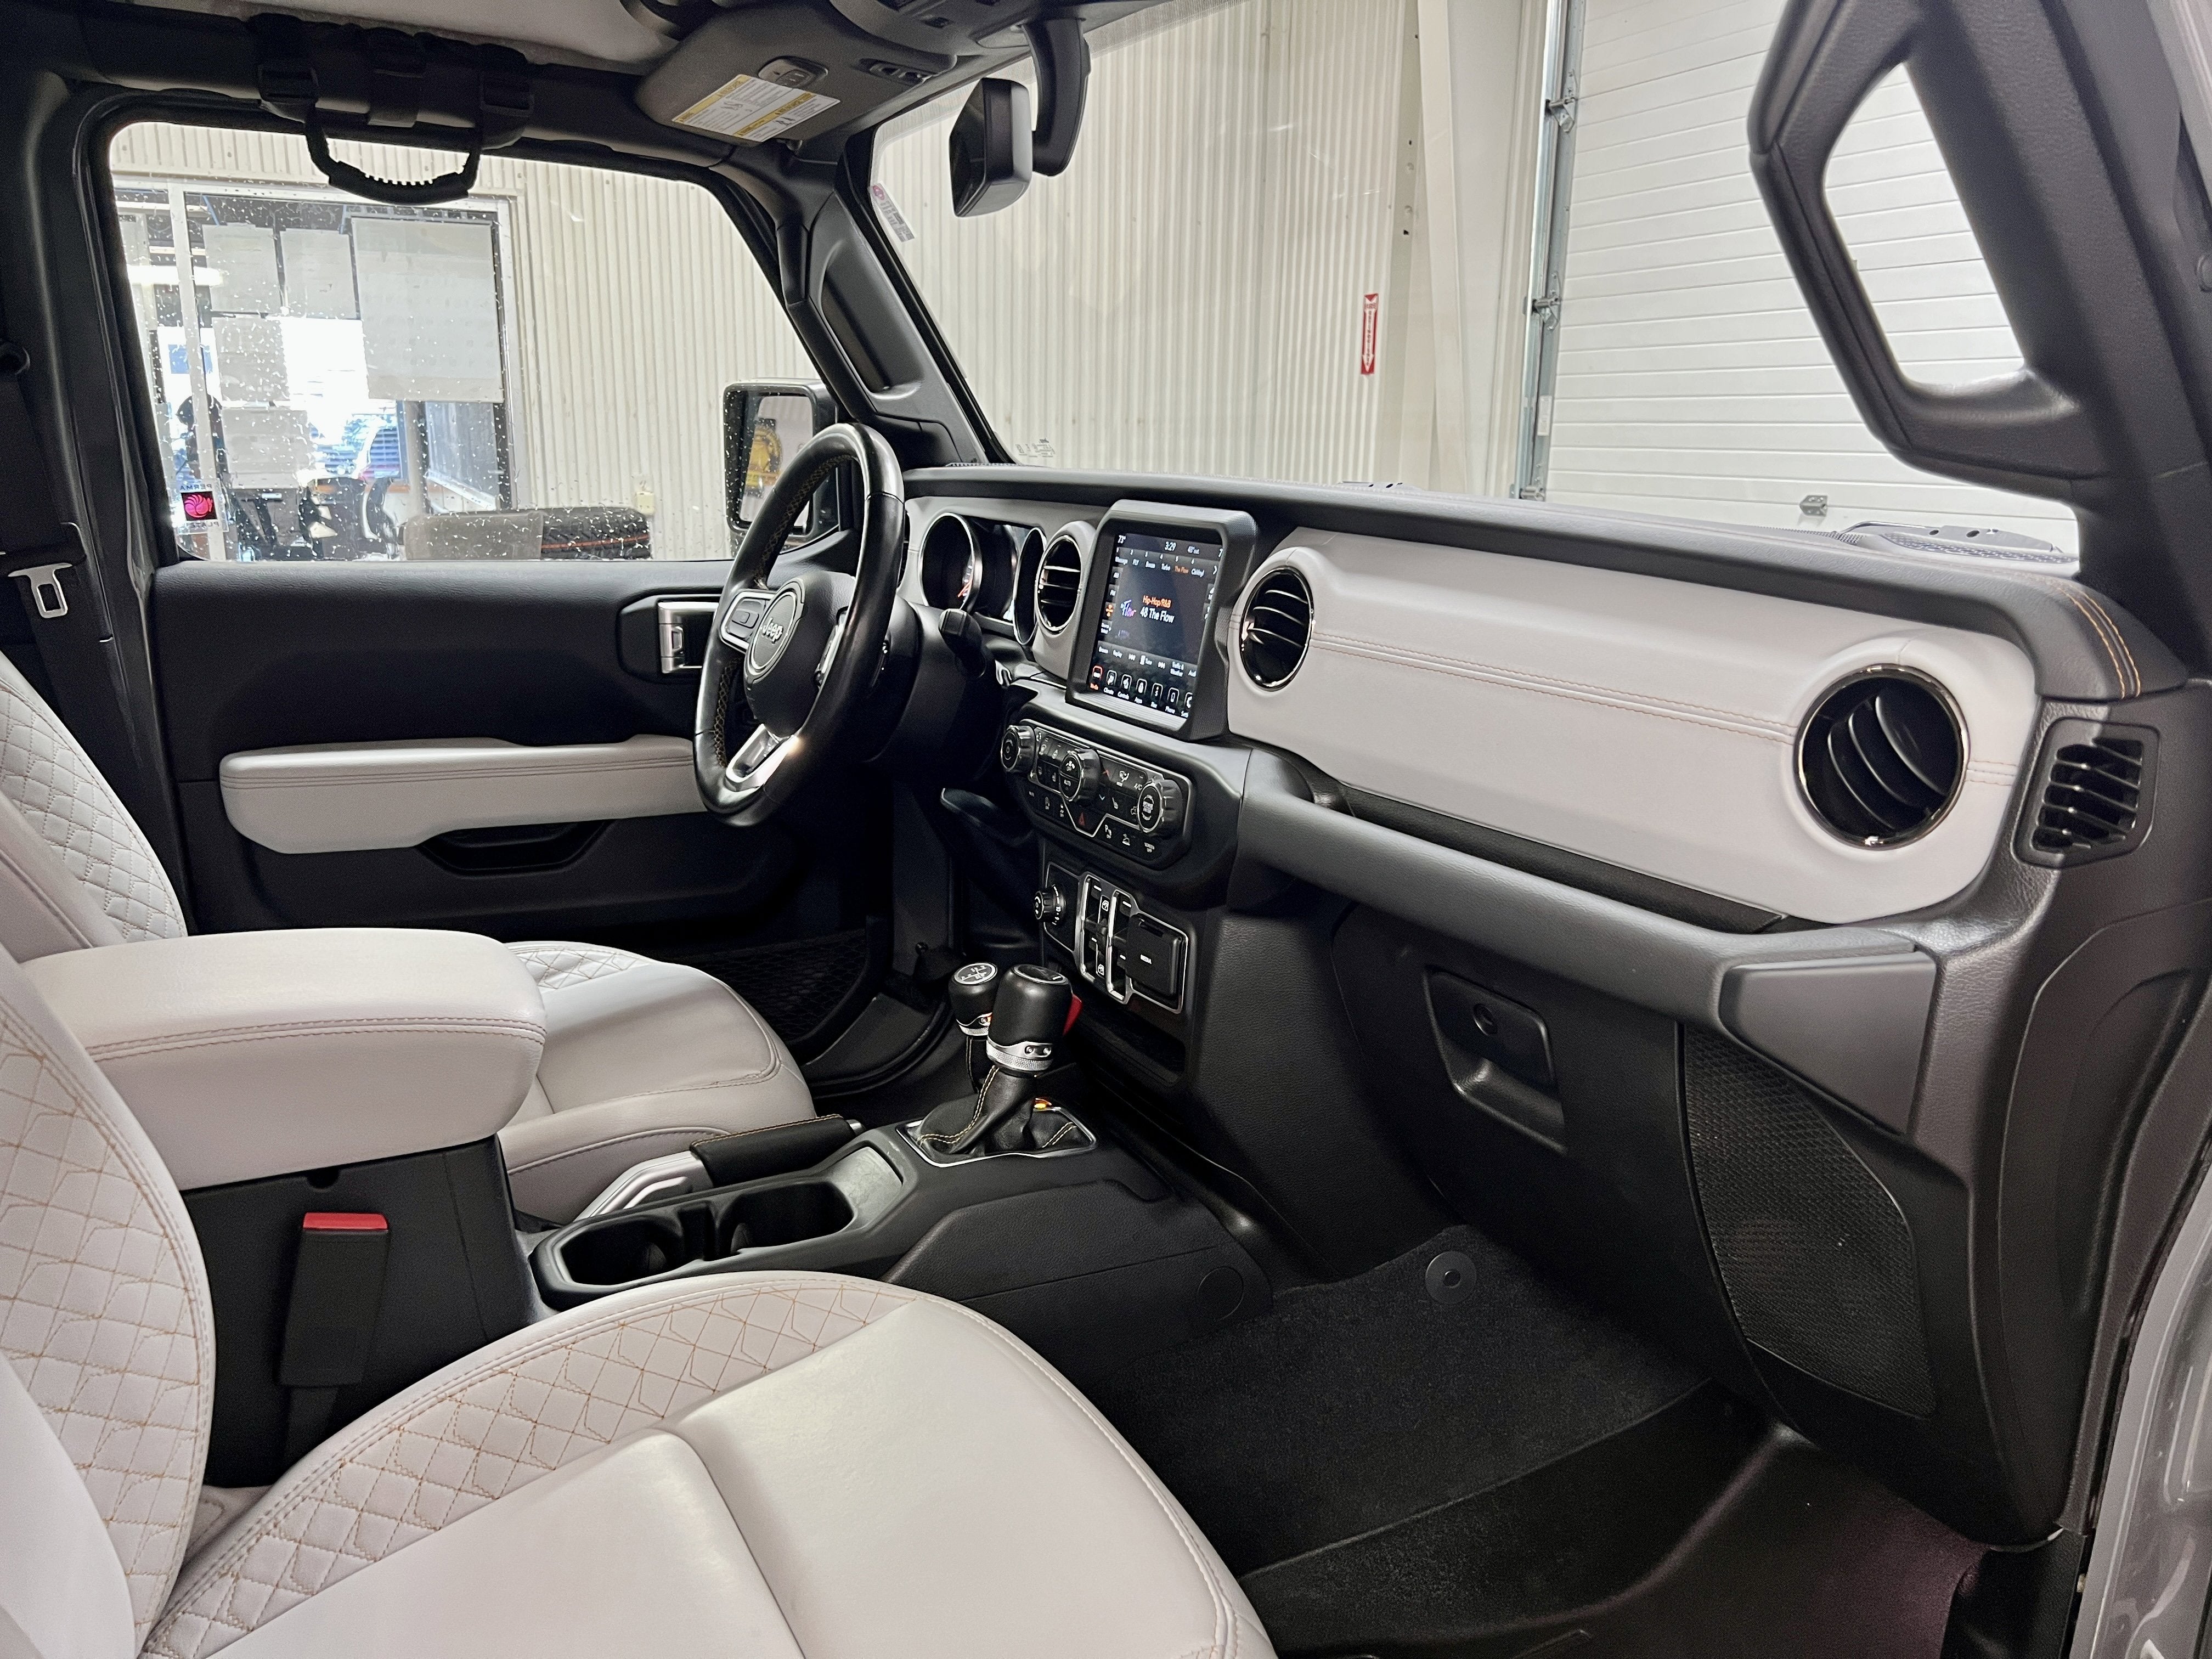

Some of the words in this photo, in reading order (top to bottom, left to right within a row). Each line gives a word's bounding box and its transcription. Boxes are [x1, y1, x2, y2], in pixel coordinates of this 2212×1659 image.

[1164, 541, 1176, 551] 3:29
[1142, 594, 1172, 609] Hip-Hop/R&B
[1139, 606, 1148, 618] 48
[1149, 607, 1159, 620] The
[1160, 610, 1175, 623] Flow
[762, 618, 783, 642] Jeep
